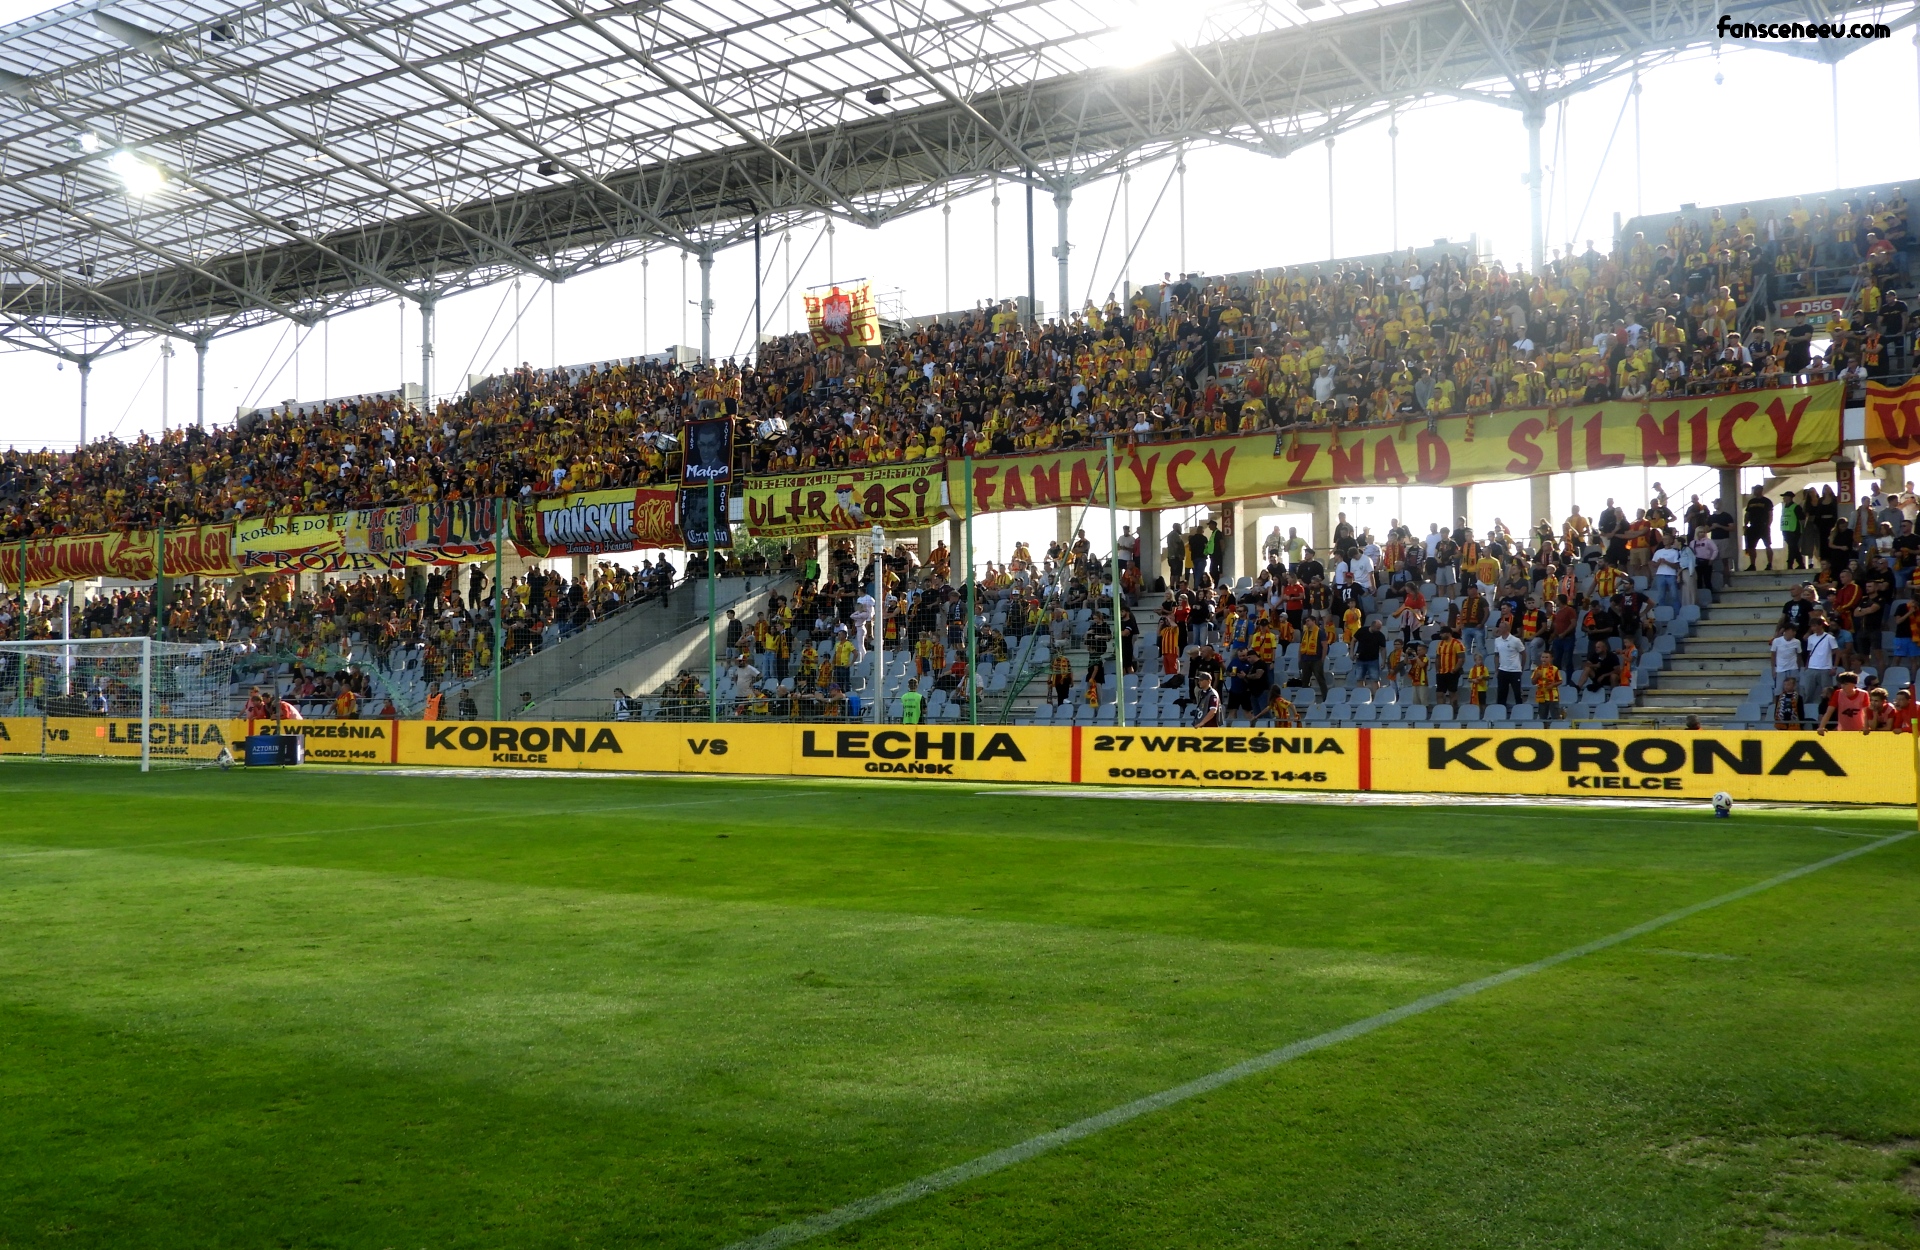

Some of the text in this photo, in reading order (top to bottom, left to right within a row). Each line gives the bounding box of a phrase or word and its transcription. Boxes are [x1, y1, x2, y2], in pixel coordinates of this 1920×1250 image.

[1801, 300, 1833, 313] D5G
[1287, 429, 1450, 487] ZNAD
[1506, 395, 1812, 475] SILNICY
[1840, 470, 1851, 503] D5D
[241, 516, 348, 542] KORONĘ DOT
[543, 498, 638, 546] KOŃSKIE
[1224, 509, 1232, 536] D4D
[109, 722, 225, 745] LECHIA
[284, 722, 385, 739] WRZEŚNIA
[426, 726, 623, 753] KORONA
[150, 745, 188, 755] DAŃSK
[802, 730, 1027, 761] LECHIA
[1094, 732, 1344, 754] 27 WRZEŚNIA
[493, 753, 547, 763] KIELCE
[865, 760, 953, 774] GDAŃSK
[1428, 737, 1848, 776] KORONA
[1109, 768, 1199, 780] SOBOTA,
[1271, 771, 1327, 782] 14:45
[1568, 775, 1683, 790] KIELCE
